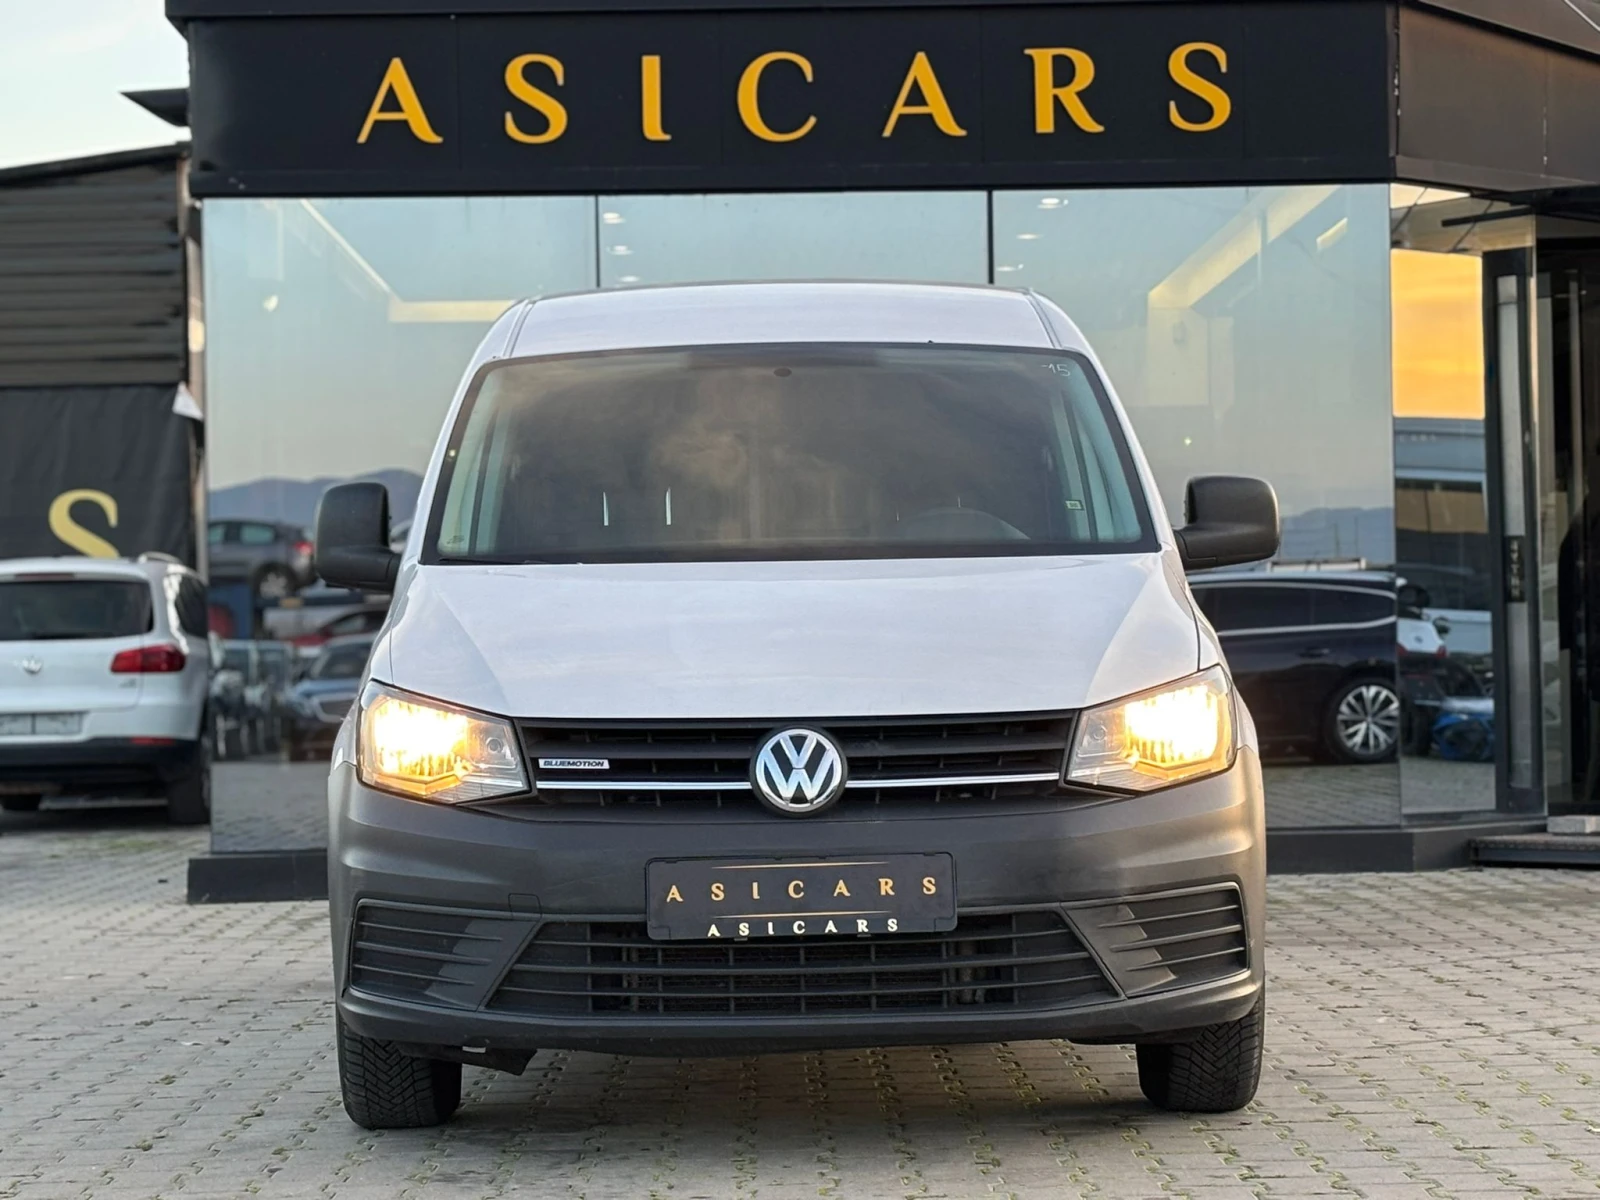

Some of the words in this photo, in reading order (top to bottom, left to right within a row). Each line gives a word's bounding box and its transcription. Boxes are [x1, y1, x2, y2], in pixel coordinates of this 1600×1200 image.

[359, 42, 1232, 144] ASICARS
[542, 759, 605, 768] BLUEMOTION
[758, 730, 841, 809] VW
[666, 876, 938, 903] ASICARS
[707, 918, 899, 938] ASICARS
